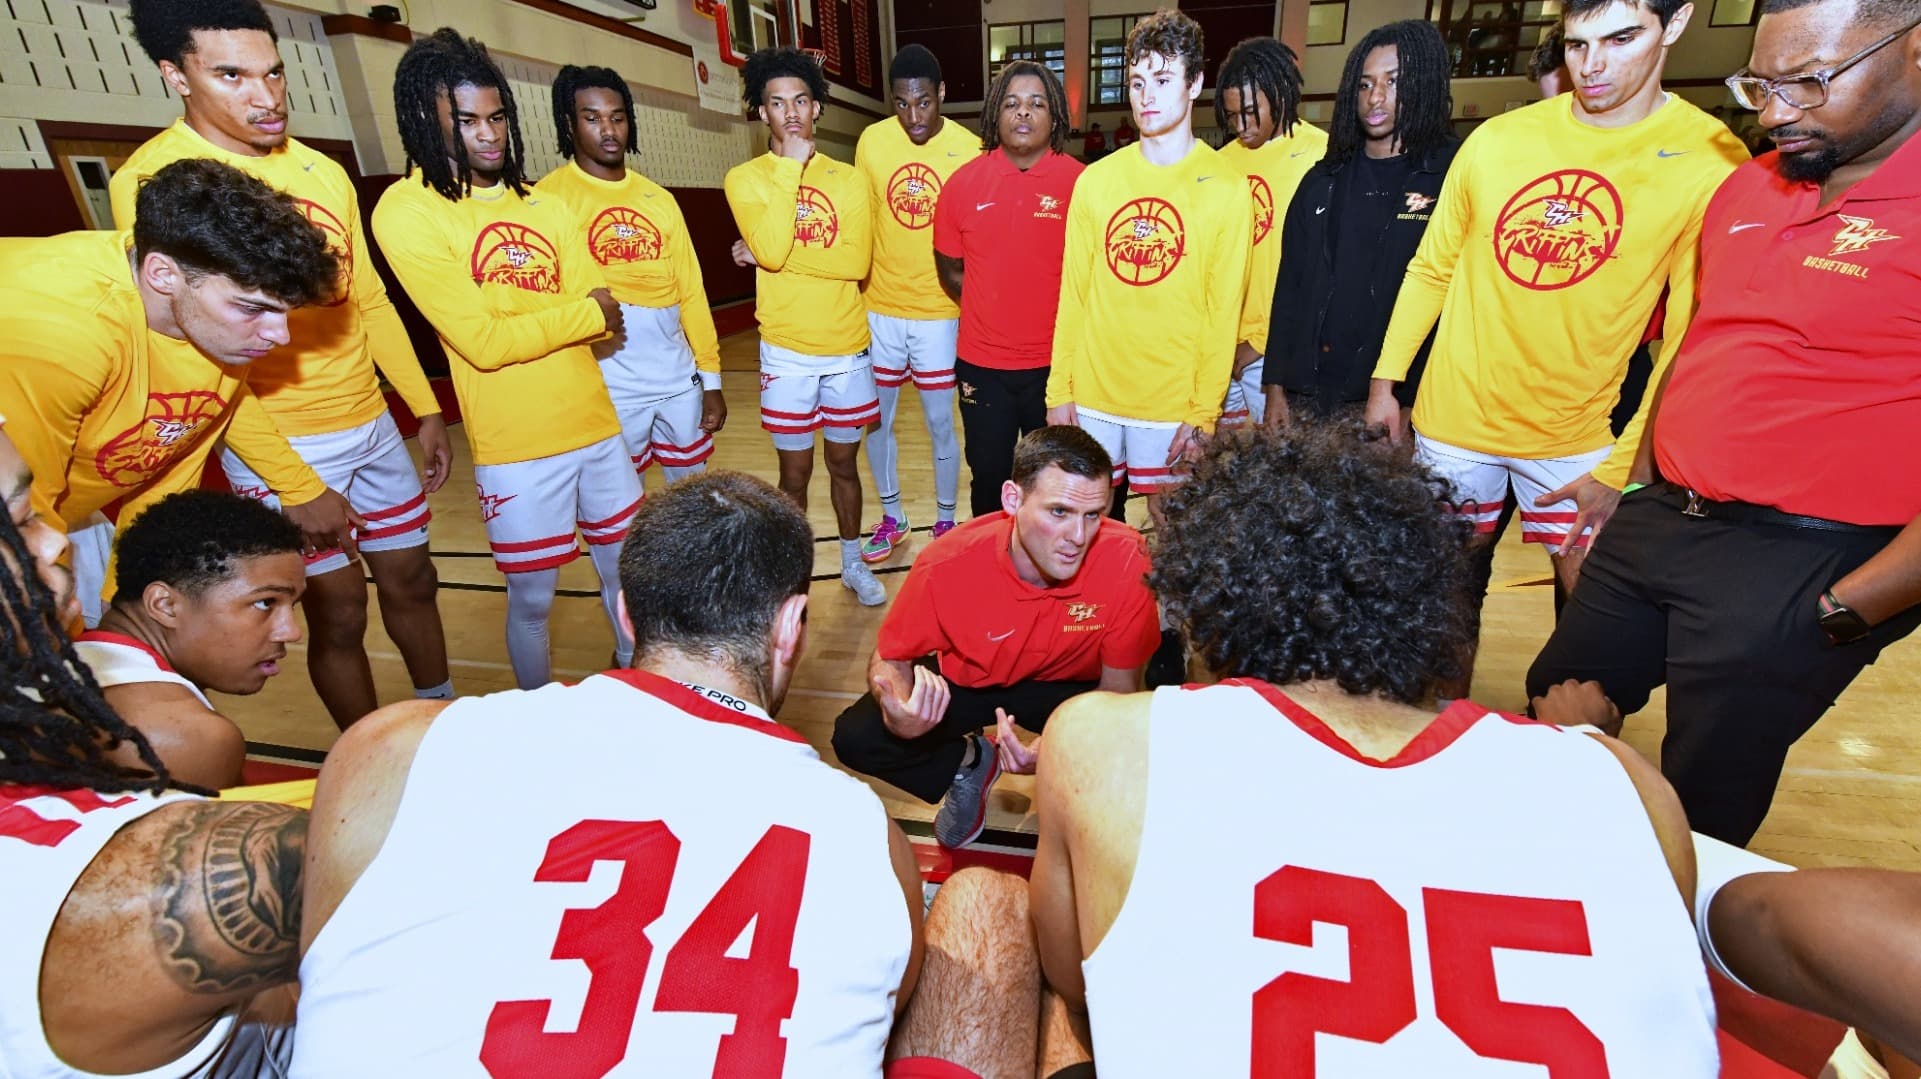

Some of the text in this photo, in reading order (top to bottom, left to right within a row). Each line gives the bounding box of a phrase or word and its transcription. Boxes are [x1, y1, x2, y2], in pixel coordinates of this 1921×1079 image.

[1802, 254, 1870, 279] BASKETBALL
[707, 690, 747, 711] PRO
[480, 819, 811, 1079] 34
[1251, 864, 1611, 1079] 25
